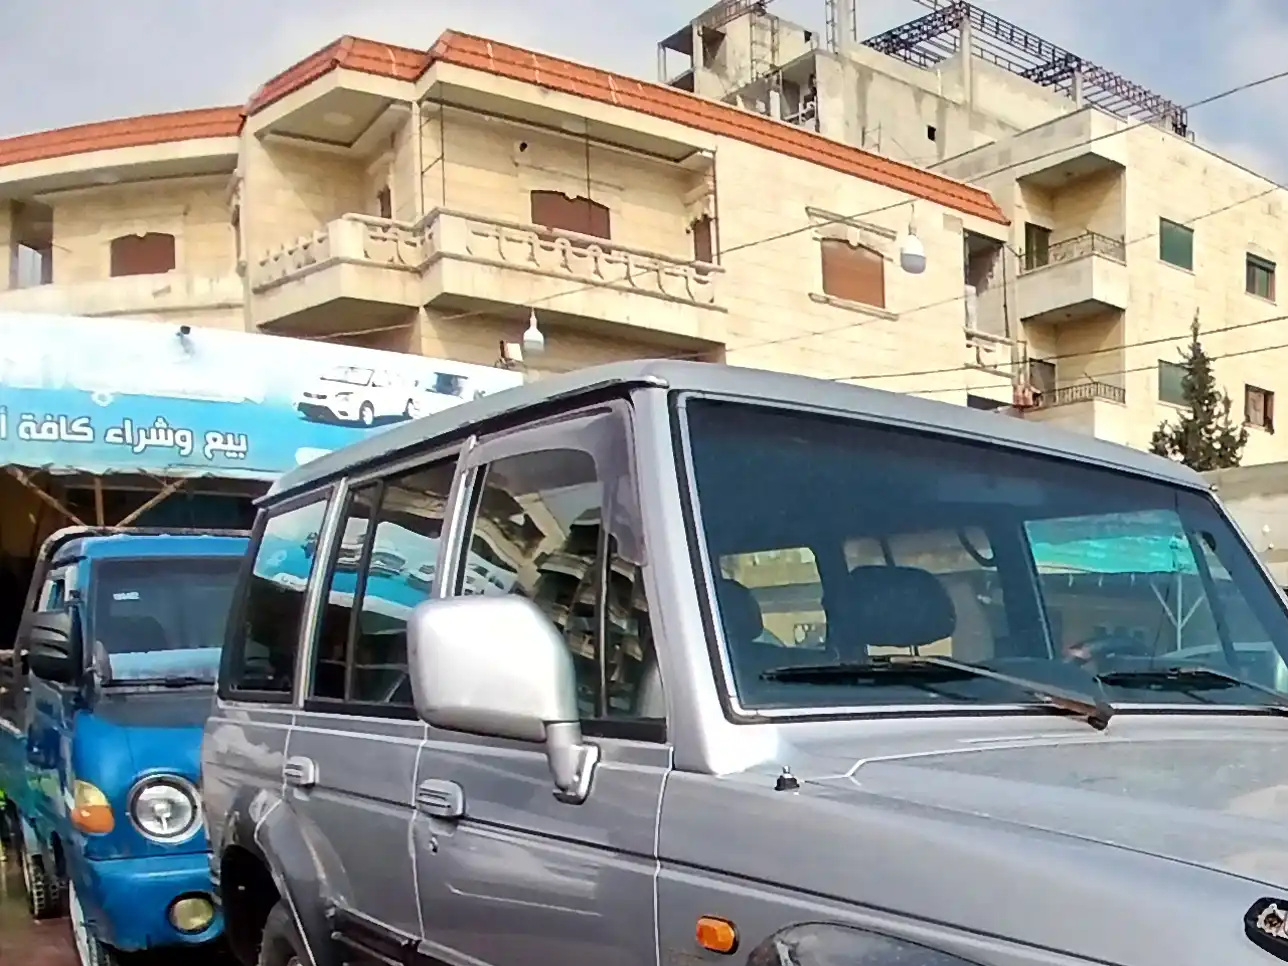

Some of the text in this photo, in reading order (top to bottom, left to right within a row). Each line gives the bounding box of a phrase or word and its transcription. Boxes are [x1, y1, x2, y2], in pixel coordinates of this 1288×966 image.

[17, 412, 95, 444] كافة
[103, 415, 194, 458] وشراء
[203, 430, 249, 461] بيع
